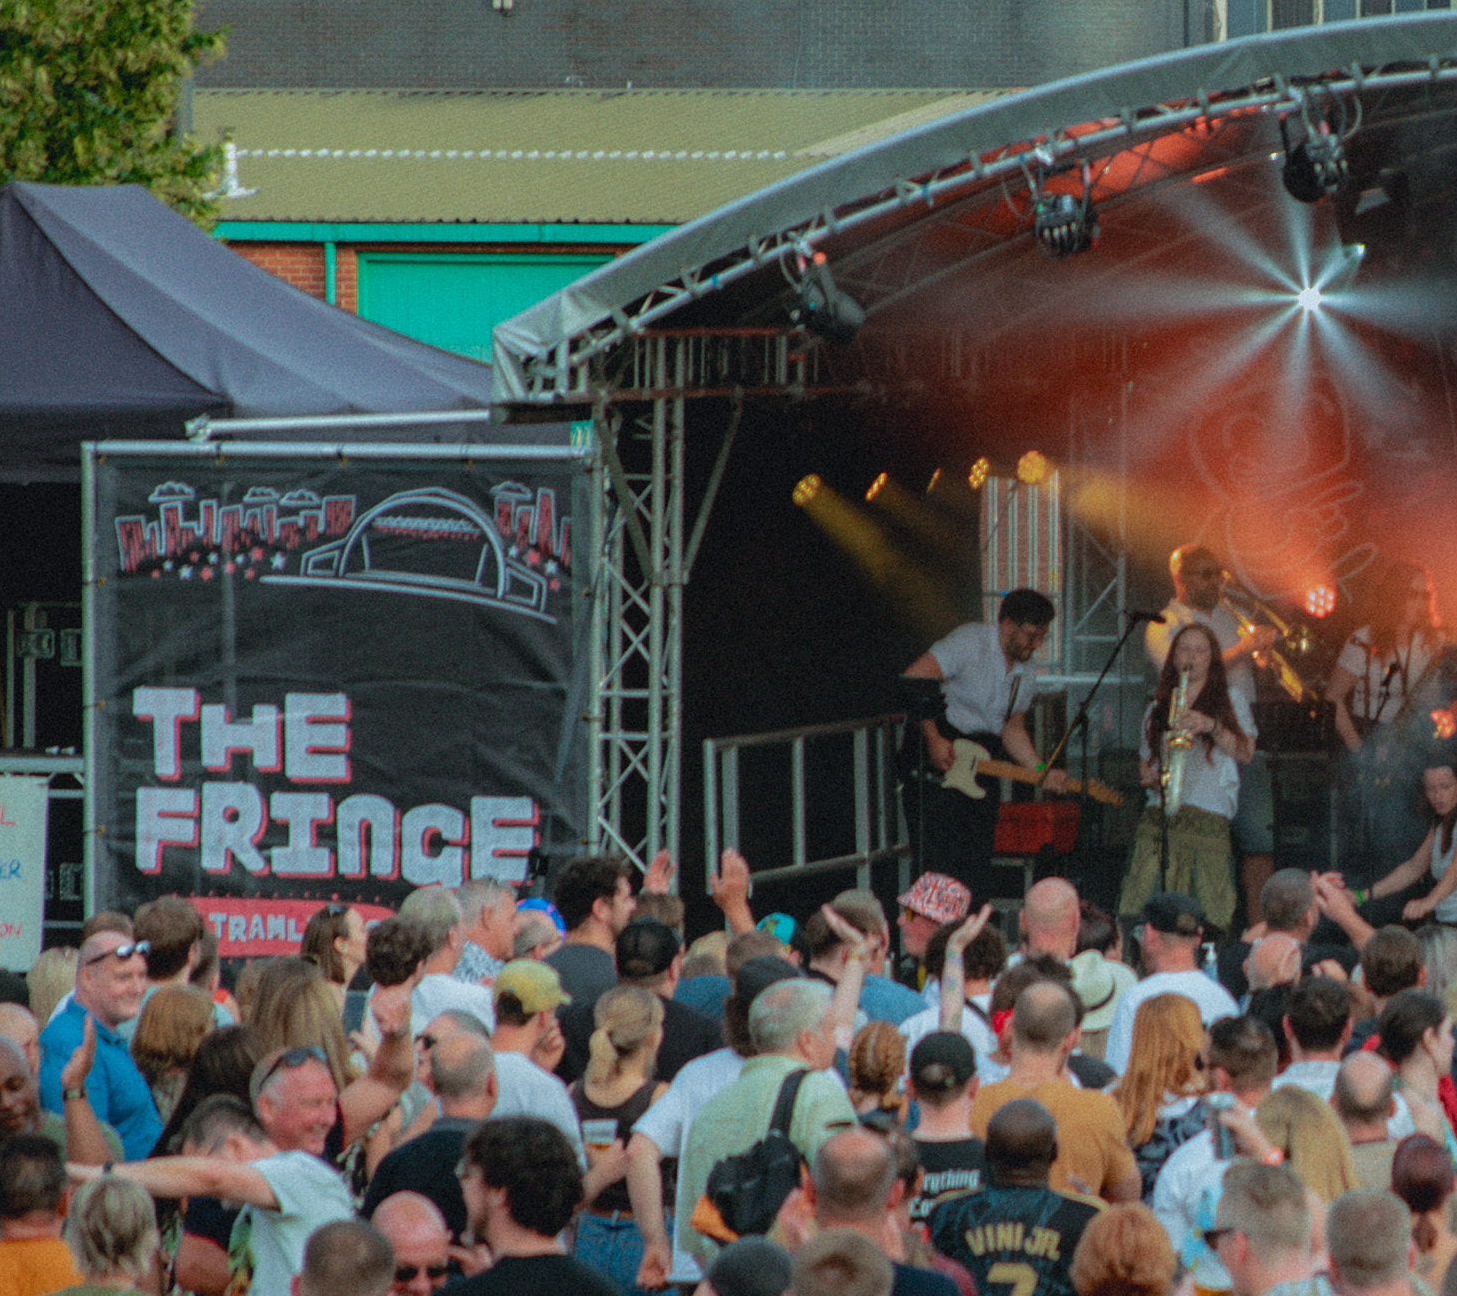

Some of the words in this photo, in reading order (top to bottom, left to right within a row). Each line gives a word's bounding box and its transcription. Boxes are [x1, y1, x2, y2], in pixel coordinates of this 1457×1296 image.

[132, 686, 352, 784] THE
[134, 780, 541, 890] FRINGE
[964, 1221, 1025, 1257] VINI
